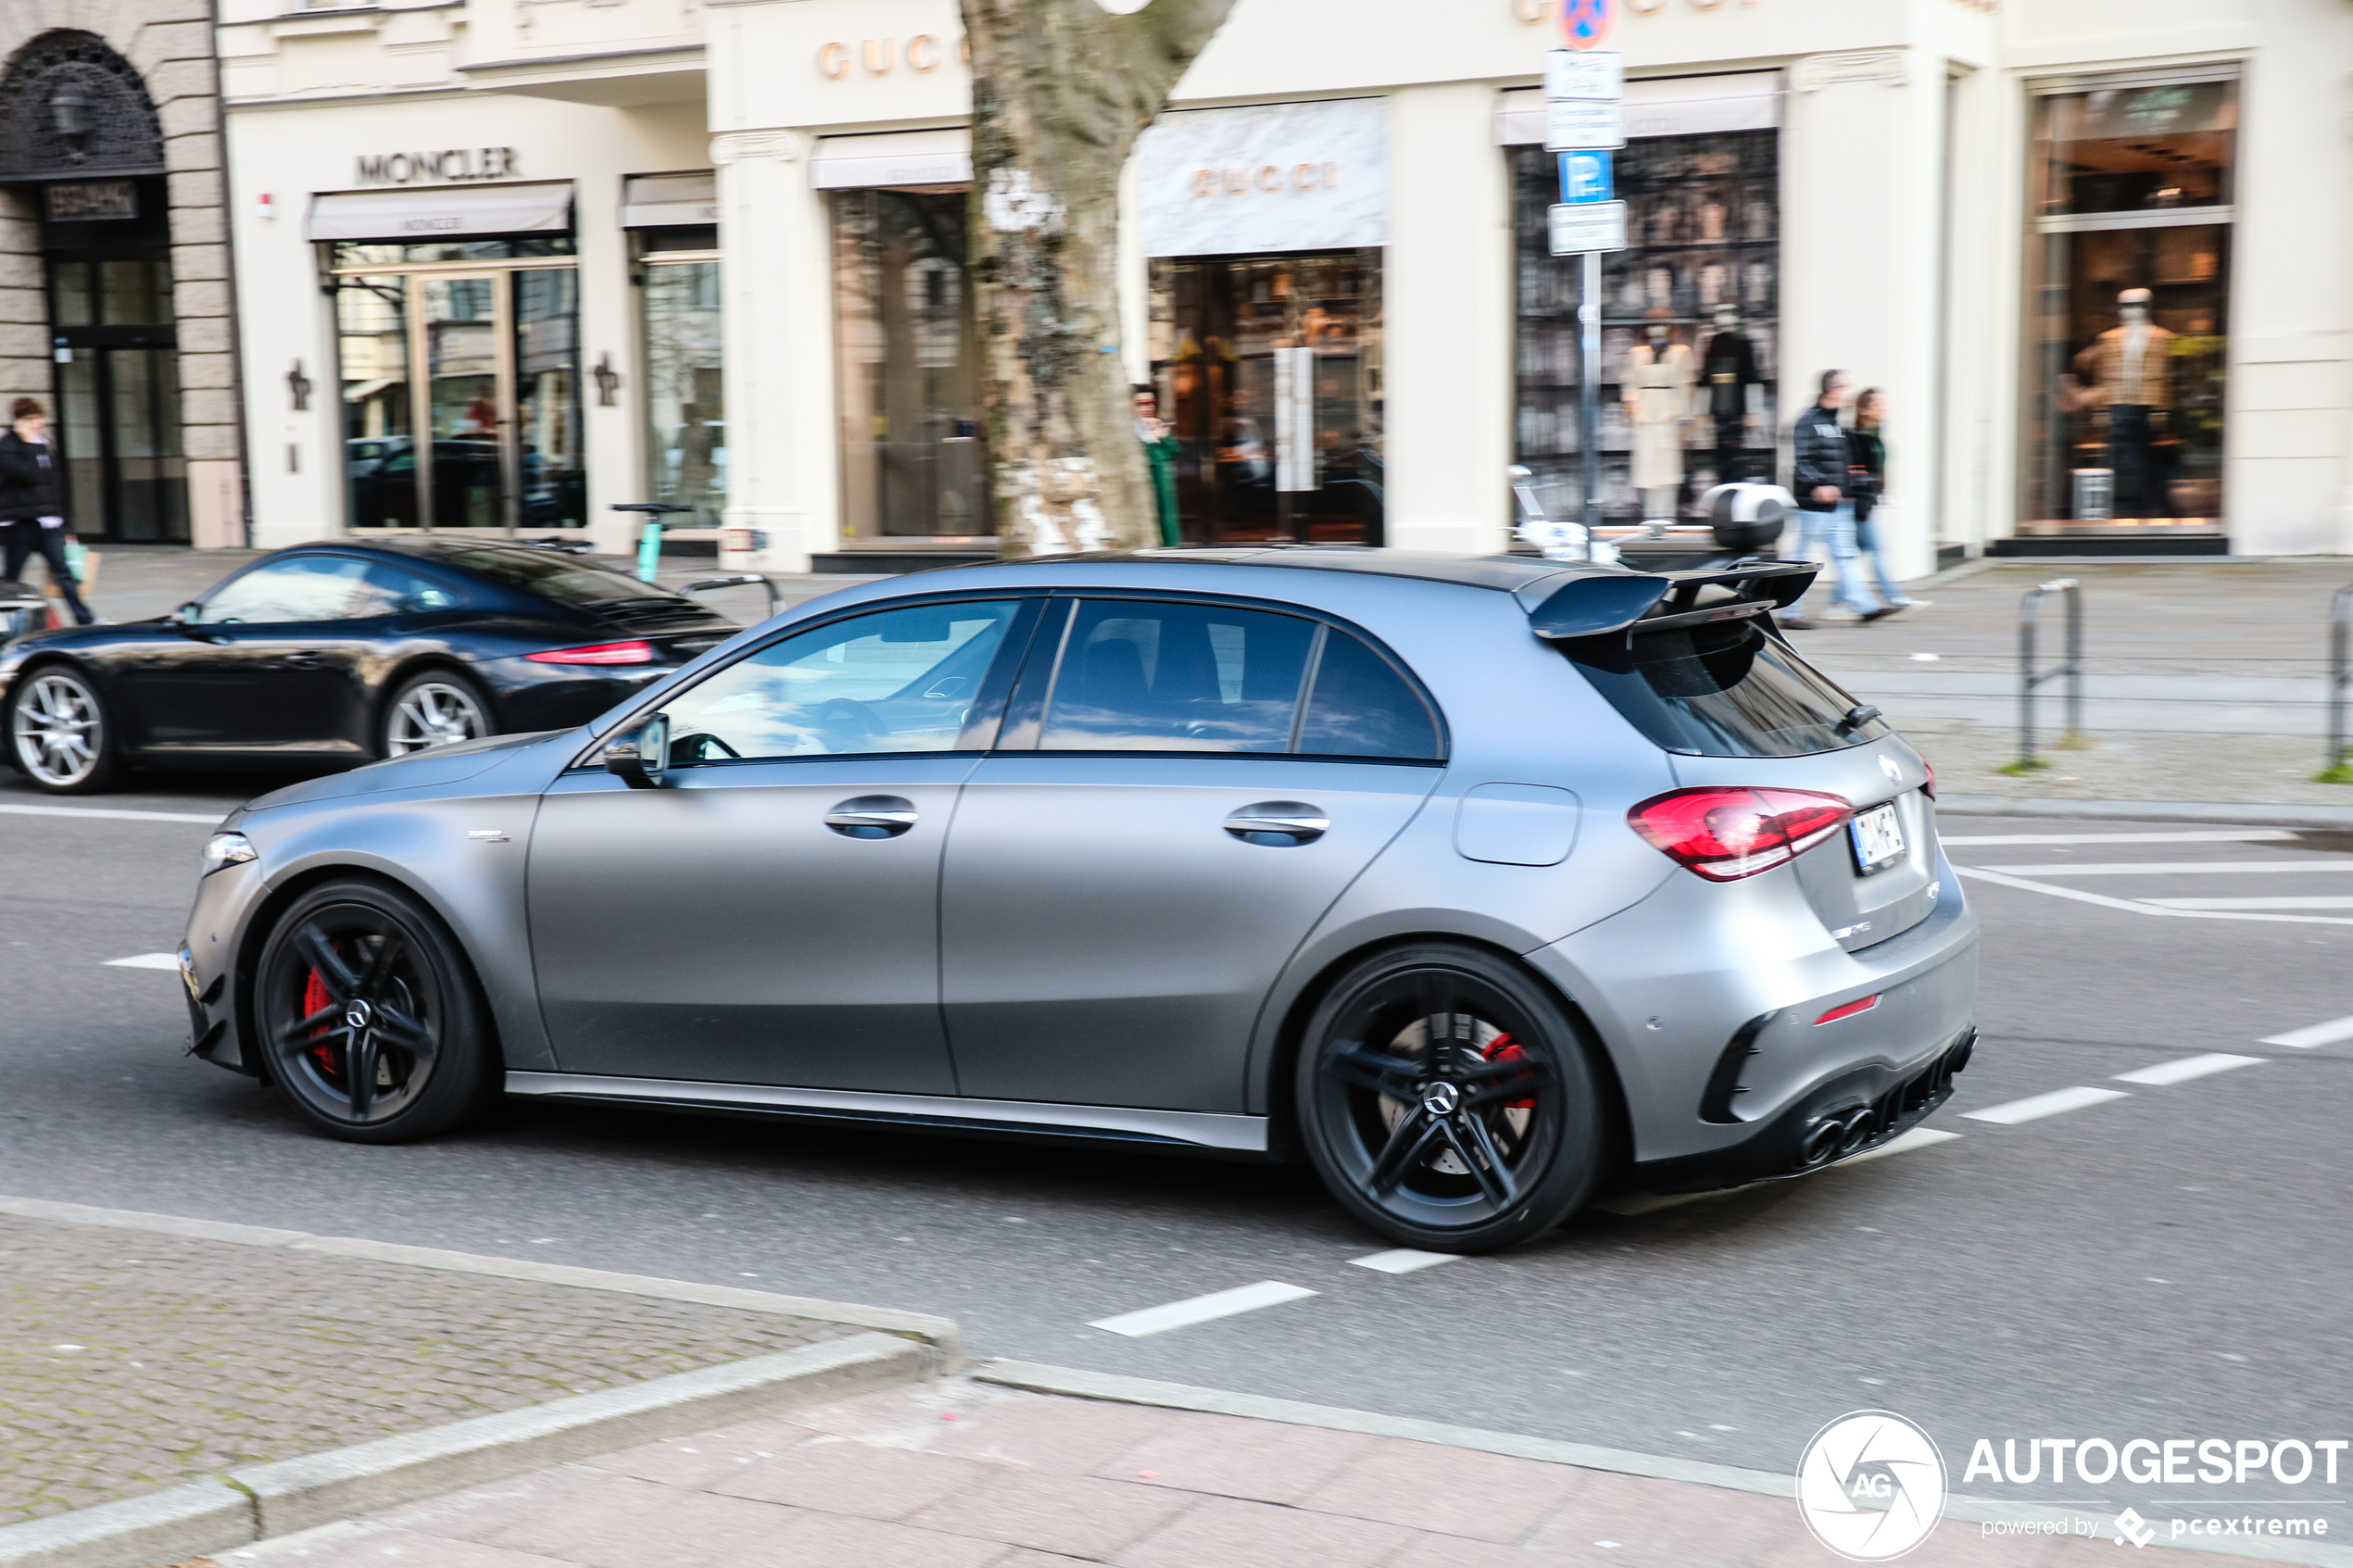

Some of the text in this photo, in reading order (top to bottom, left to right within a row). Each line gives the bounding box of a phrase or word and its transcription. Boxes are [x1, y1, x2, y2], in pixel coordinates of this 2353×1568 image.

[354, 146, 522, 184] MONCLER
[1189, 162, 1340, 197] GUCCI
[1566, 156, 1601, 198] P
